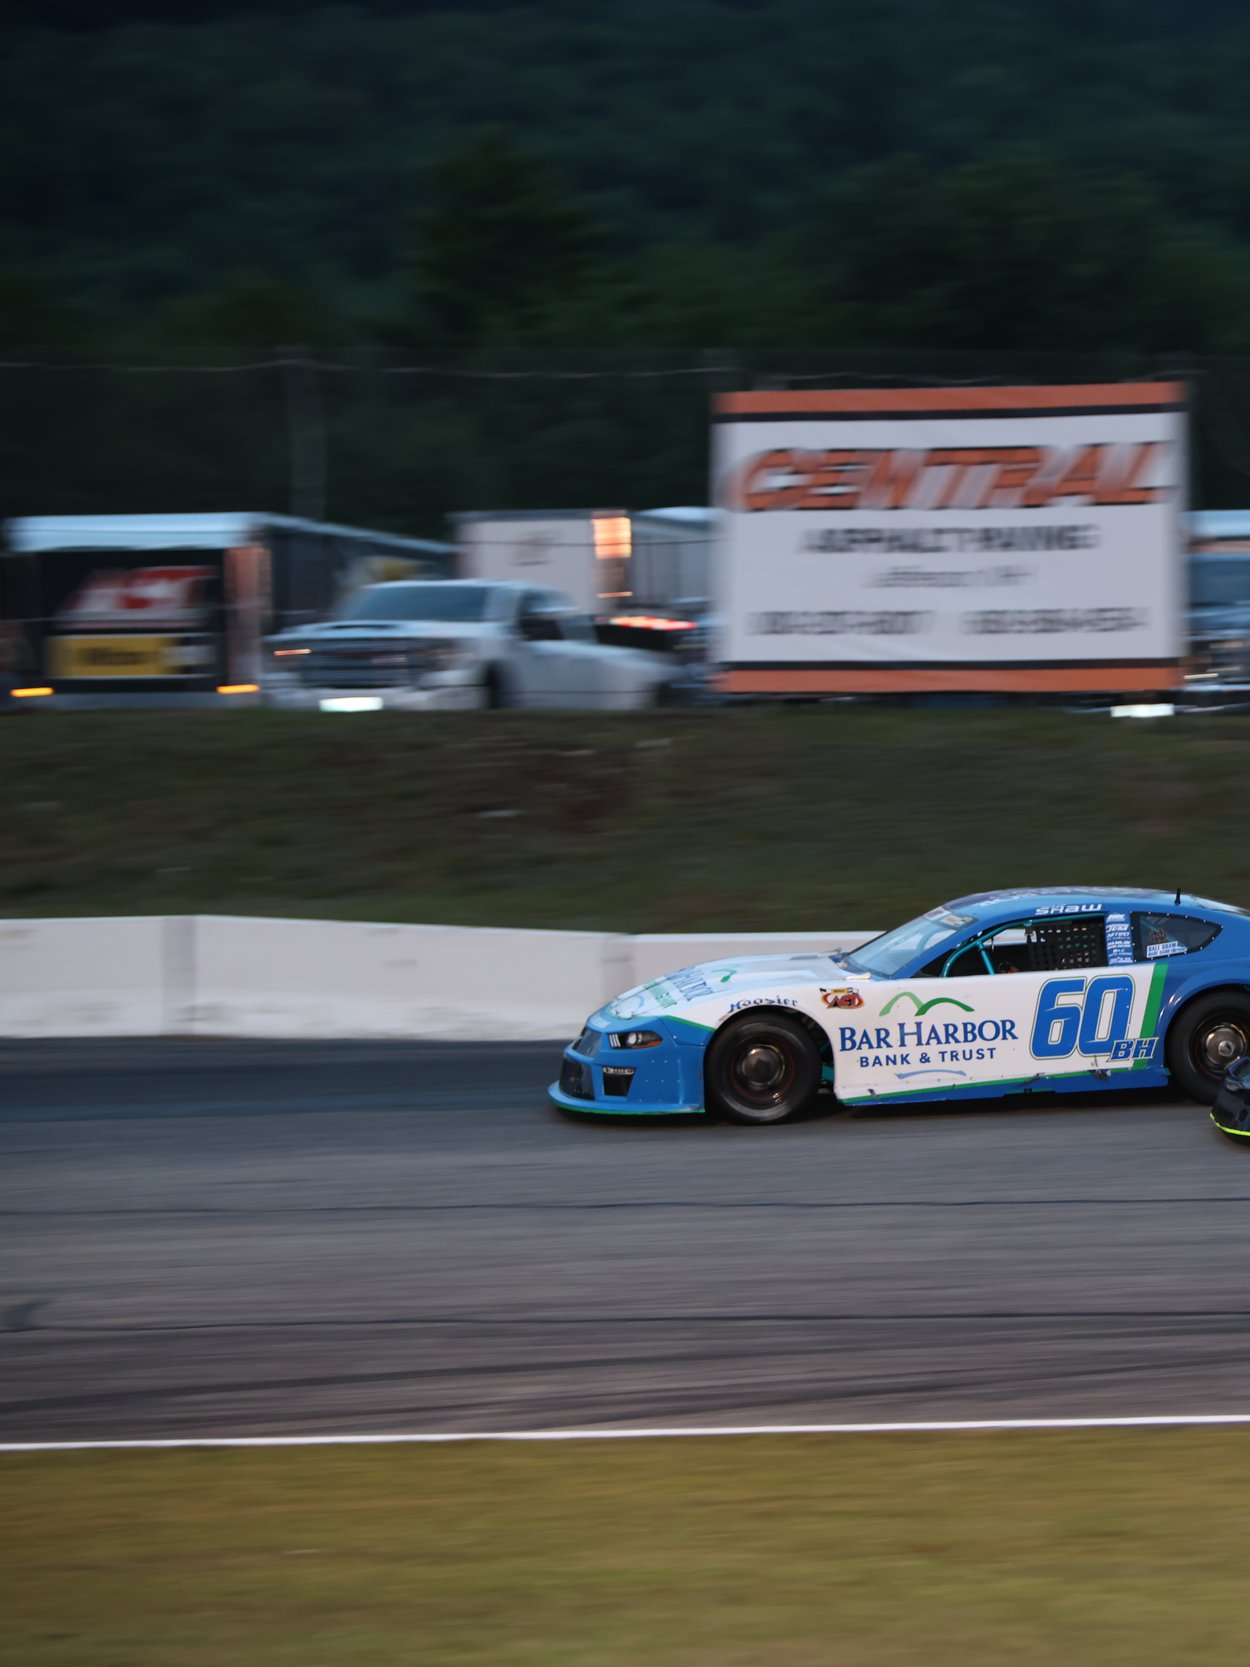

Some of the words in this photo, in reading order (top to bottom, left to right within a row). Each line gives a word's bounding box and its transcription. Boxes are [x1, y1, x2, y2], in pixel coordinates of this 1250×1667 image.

[725, 441, 1178, 511] CENTRAL
[1029, 974, 1135, 1060] 60
[839, 1026, 893, 1052] BAR
[897, 1019, 1018, 1047] HARBOR
[1106, 1036, 1160, 1063] BH
[859, 1054, 911, 1068] BANK
[919, 1052, 931, 1064] &
[938, 1048, 997, 1063] TRUST
